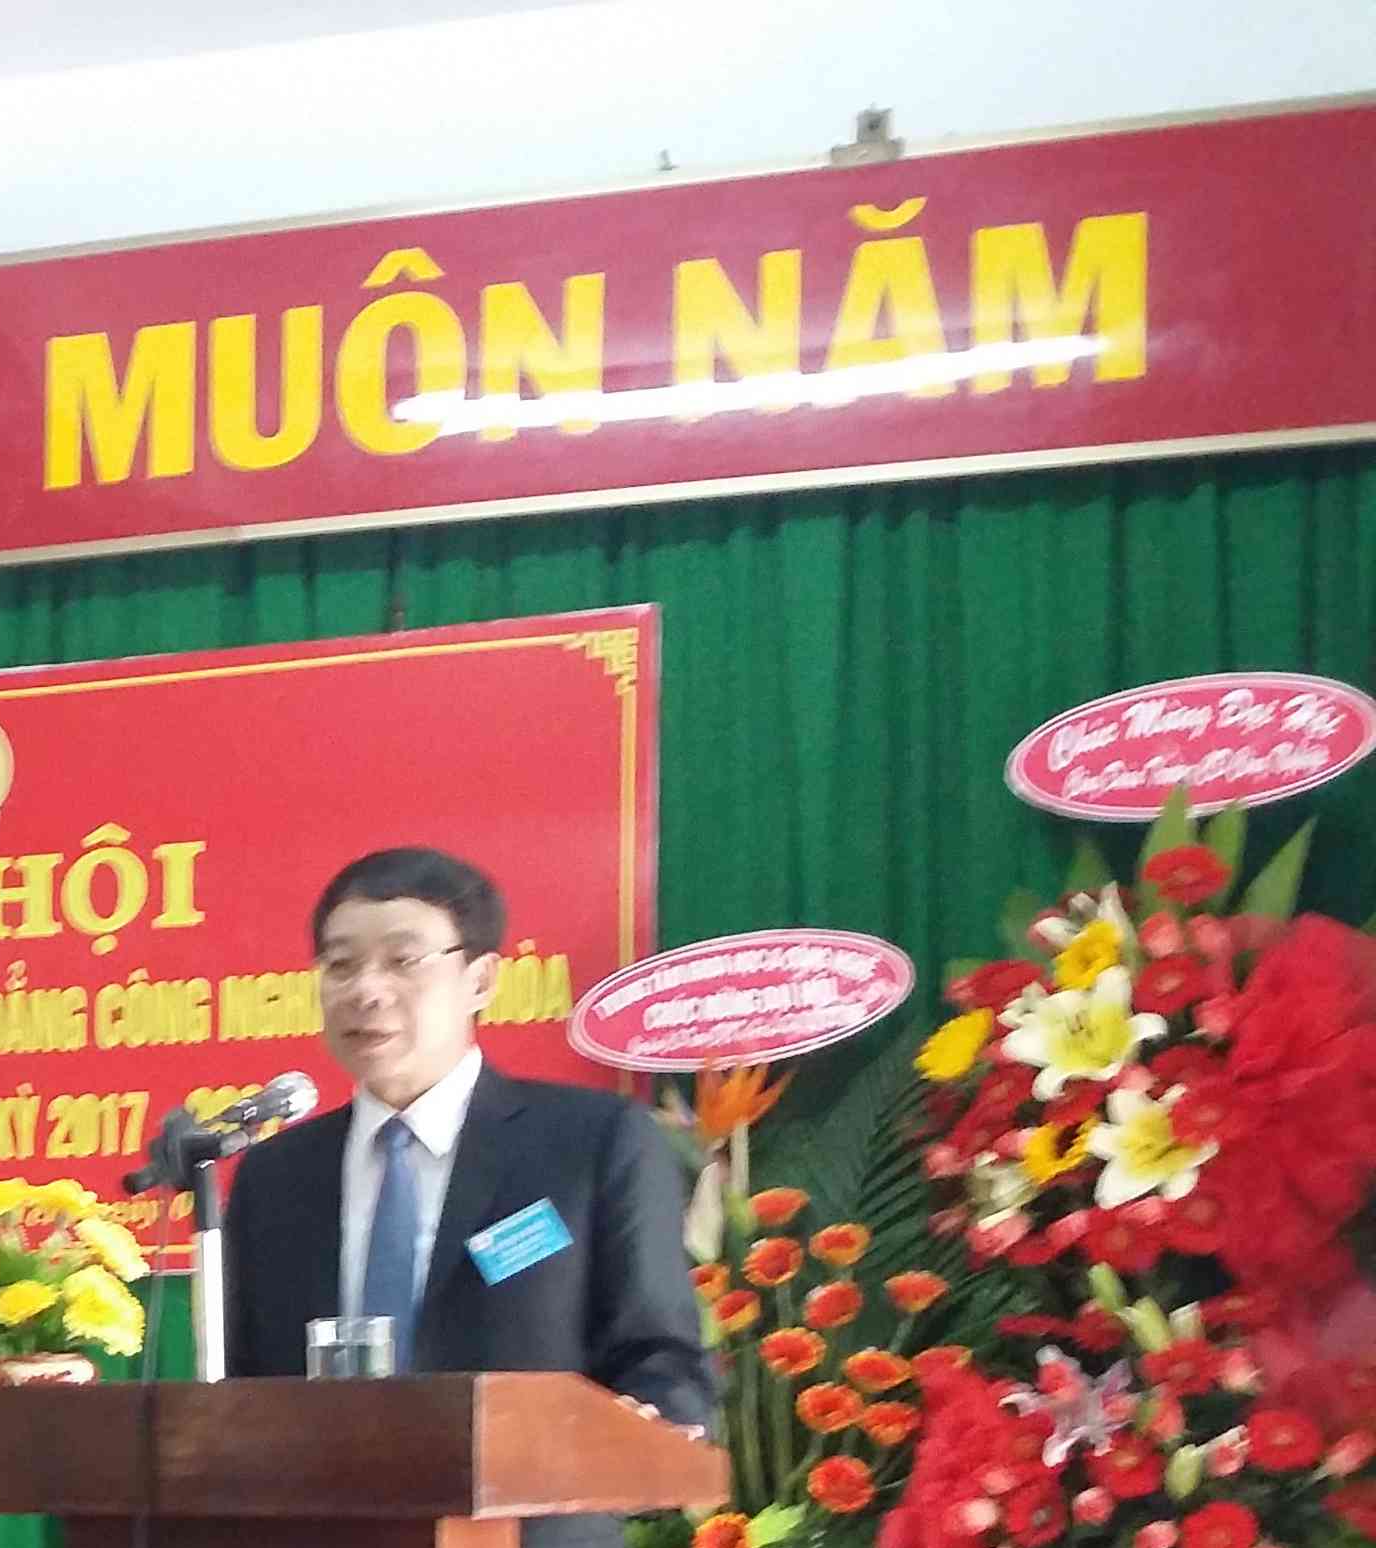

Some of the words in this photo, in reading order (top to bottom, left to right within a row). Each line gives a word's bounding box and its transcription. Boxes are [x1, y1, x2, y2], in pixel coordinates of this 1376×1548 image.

[43, 247, 607, 492] MUÔN
[671, 197, 1150, 425] NĂM
[94, 967, 213, 1049] CÔNG
[45, 1090, 150, 1160] 2017
